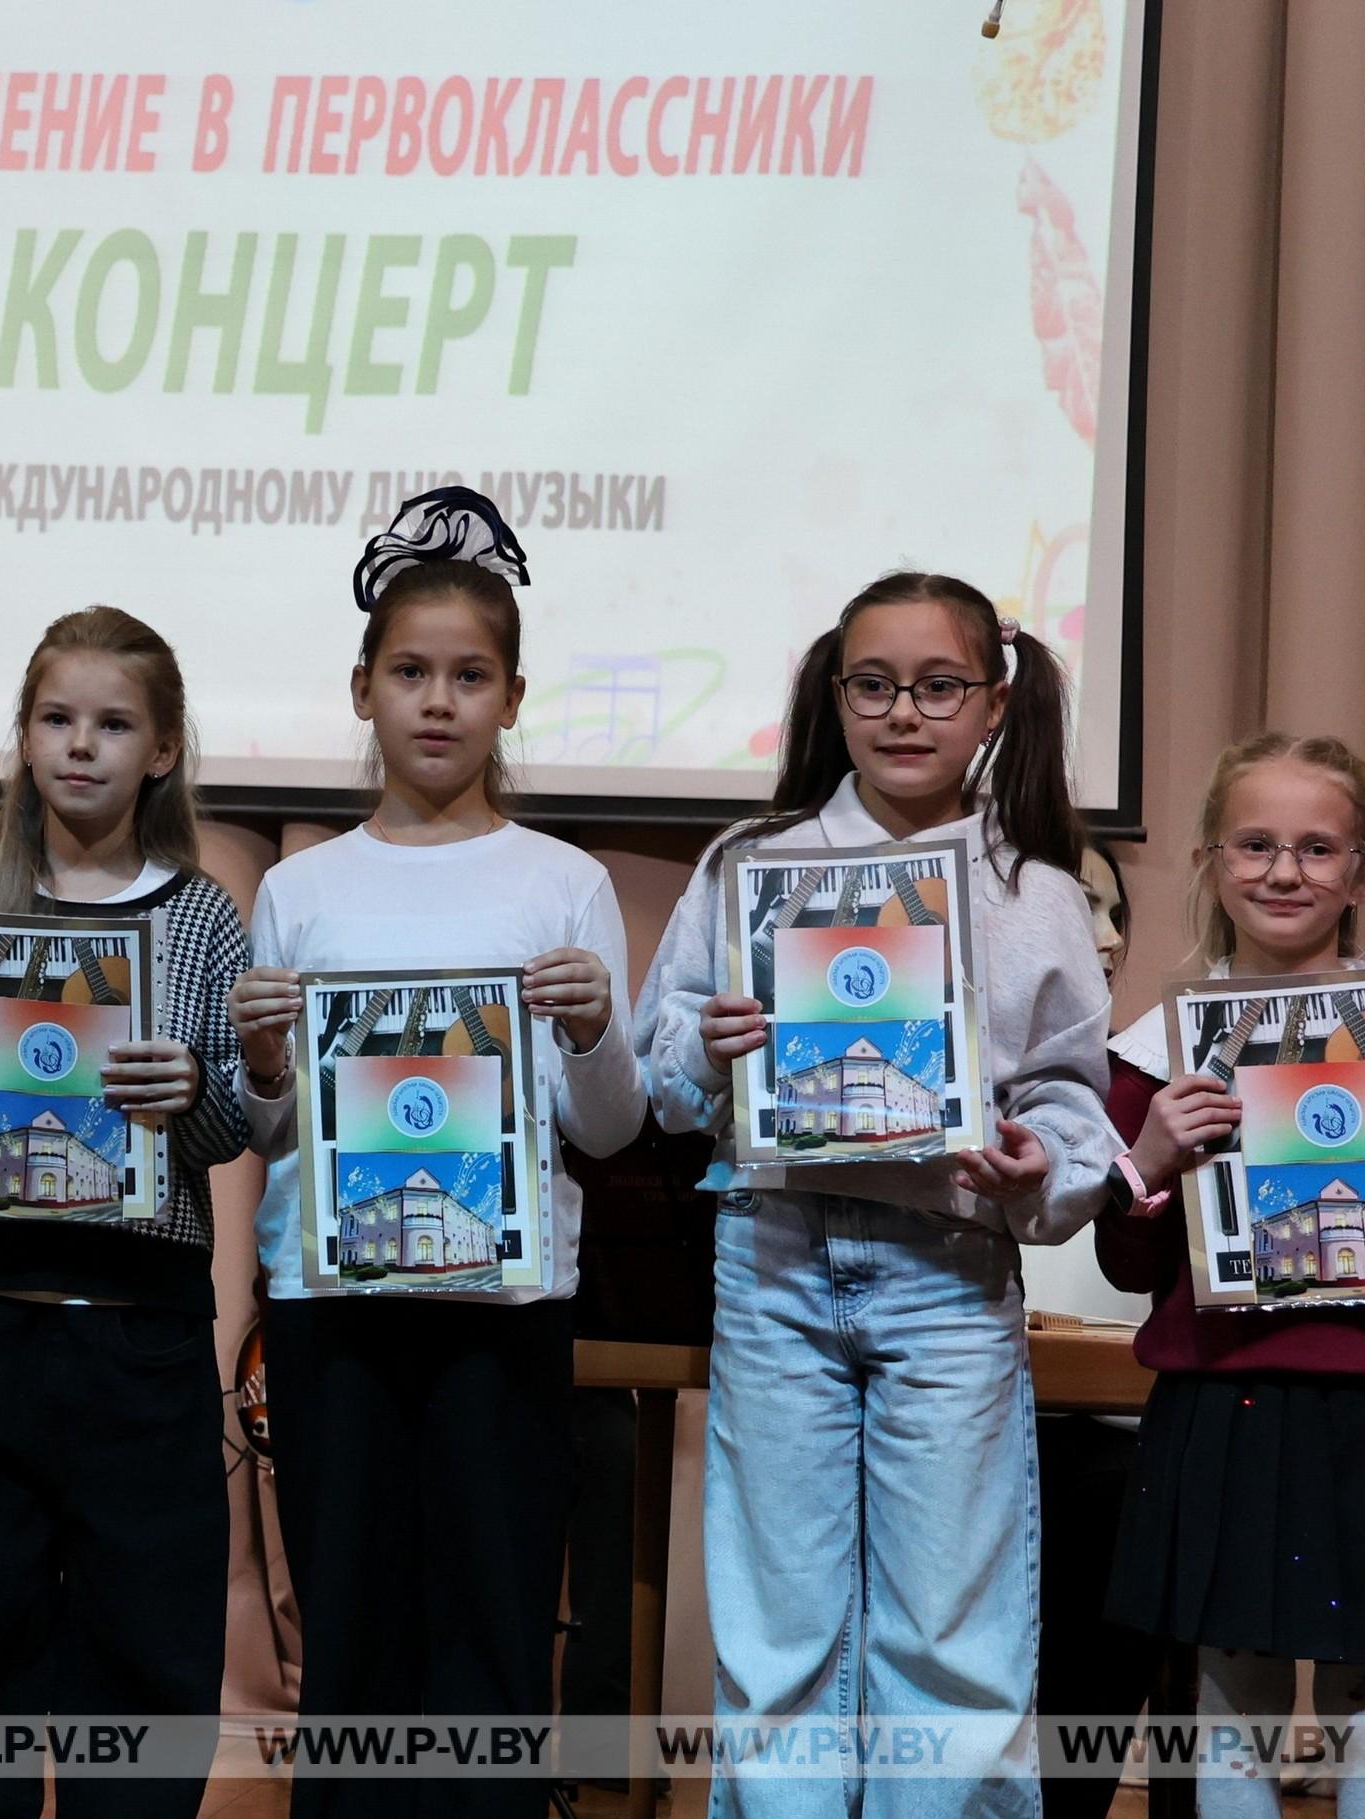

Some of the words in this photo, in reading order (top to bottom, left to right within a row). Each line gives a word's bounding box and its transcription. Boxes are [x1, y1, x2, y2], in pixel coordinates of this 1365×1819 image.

[192, 74, 235, 173] В
[262, 74, 875, 178] ПЕРВОКЛАССНИКИ
[480, 470, 666, 531] МУЗЫКИ
